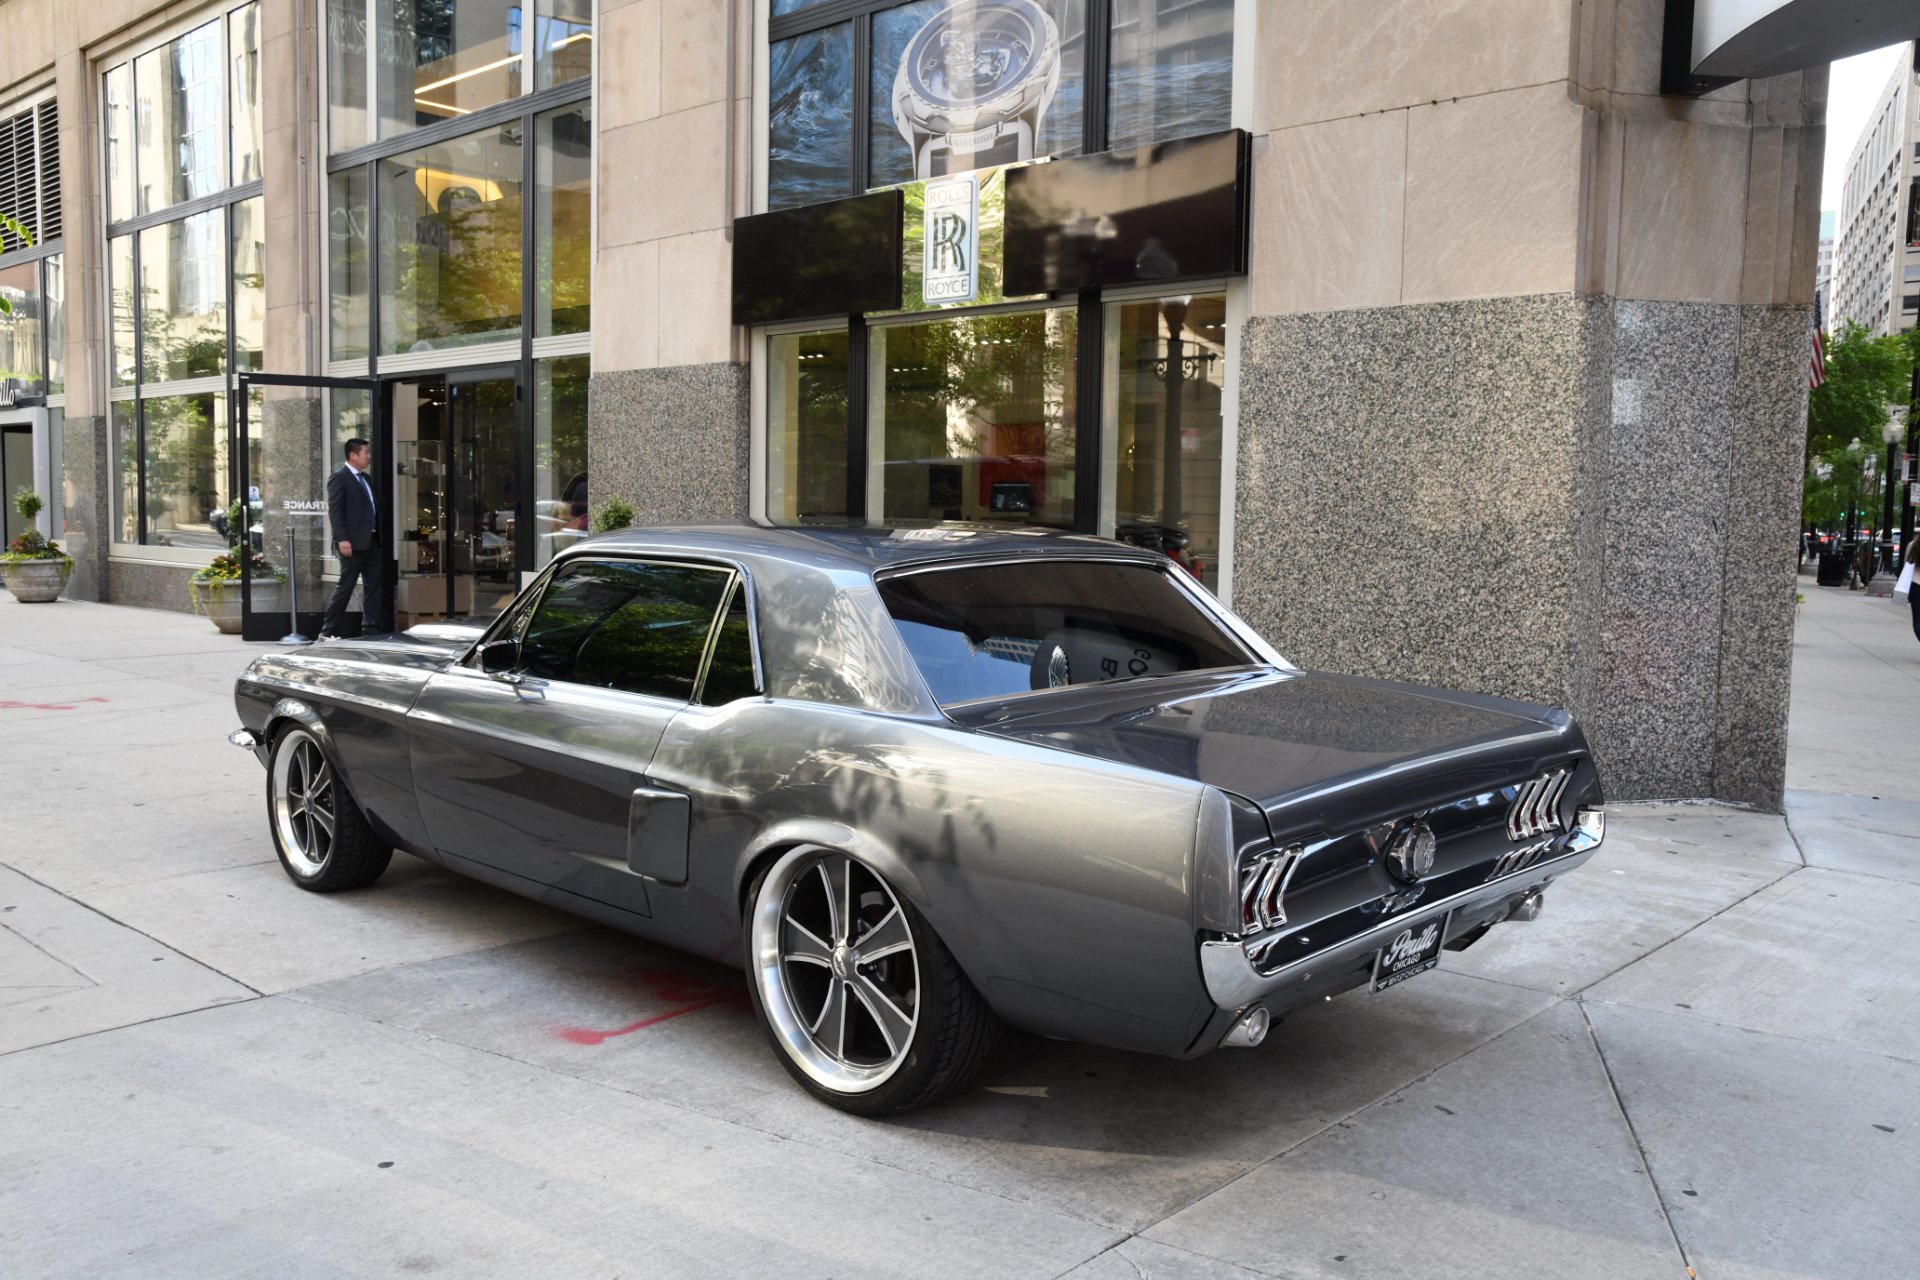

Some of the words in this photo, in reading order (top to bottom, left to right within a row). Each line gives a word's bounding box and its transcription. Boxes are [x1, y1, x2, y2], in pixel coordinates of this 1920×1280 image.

[930, 185, 969, 204] ROLLS
[928, 279, 968, 296] ROYCE
[1392, 952, 1421, 972] CHICAGO
